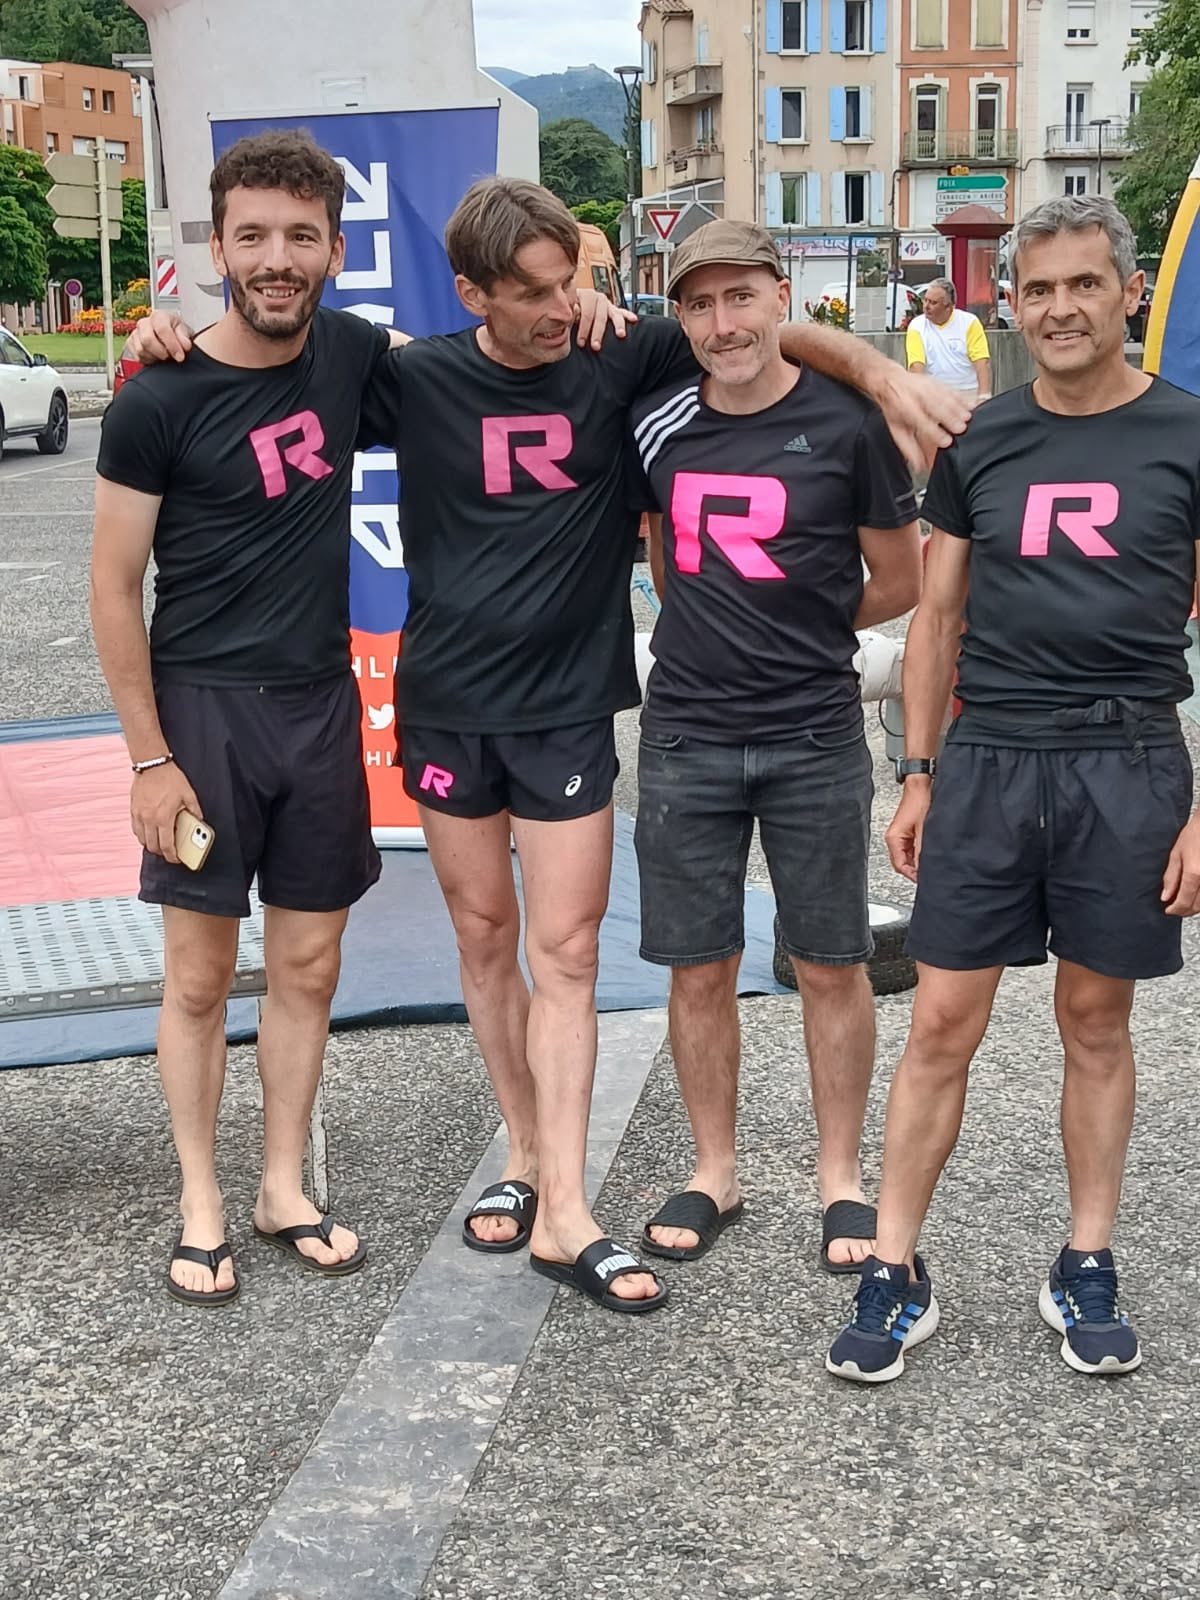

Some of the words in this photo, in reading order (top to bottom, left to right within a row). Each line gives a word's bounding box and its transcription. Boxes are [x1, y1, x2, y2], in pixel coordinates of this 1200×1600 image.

[249, 410, 334, 498] R
[482, 414, 579, 495] R
[671, 472, 787, 579] R
[1020, 482, 1120, 557] R
[420, 764, 454, 798] R
[473, 1195, 517, 1211] PUMA
